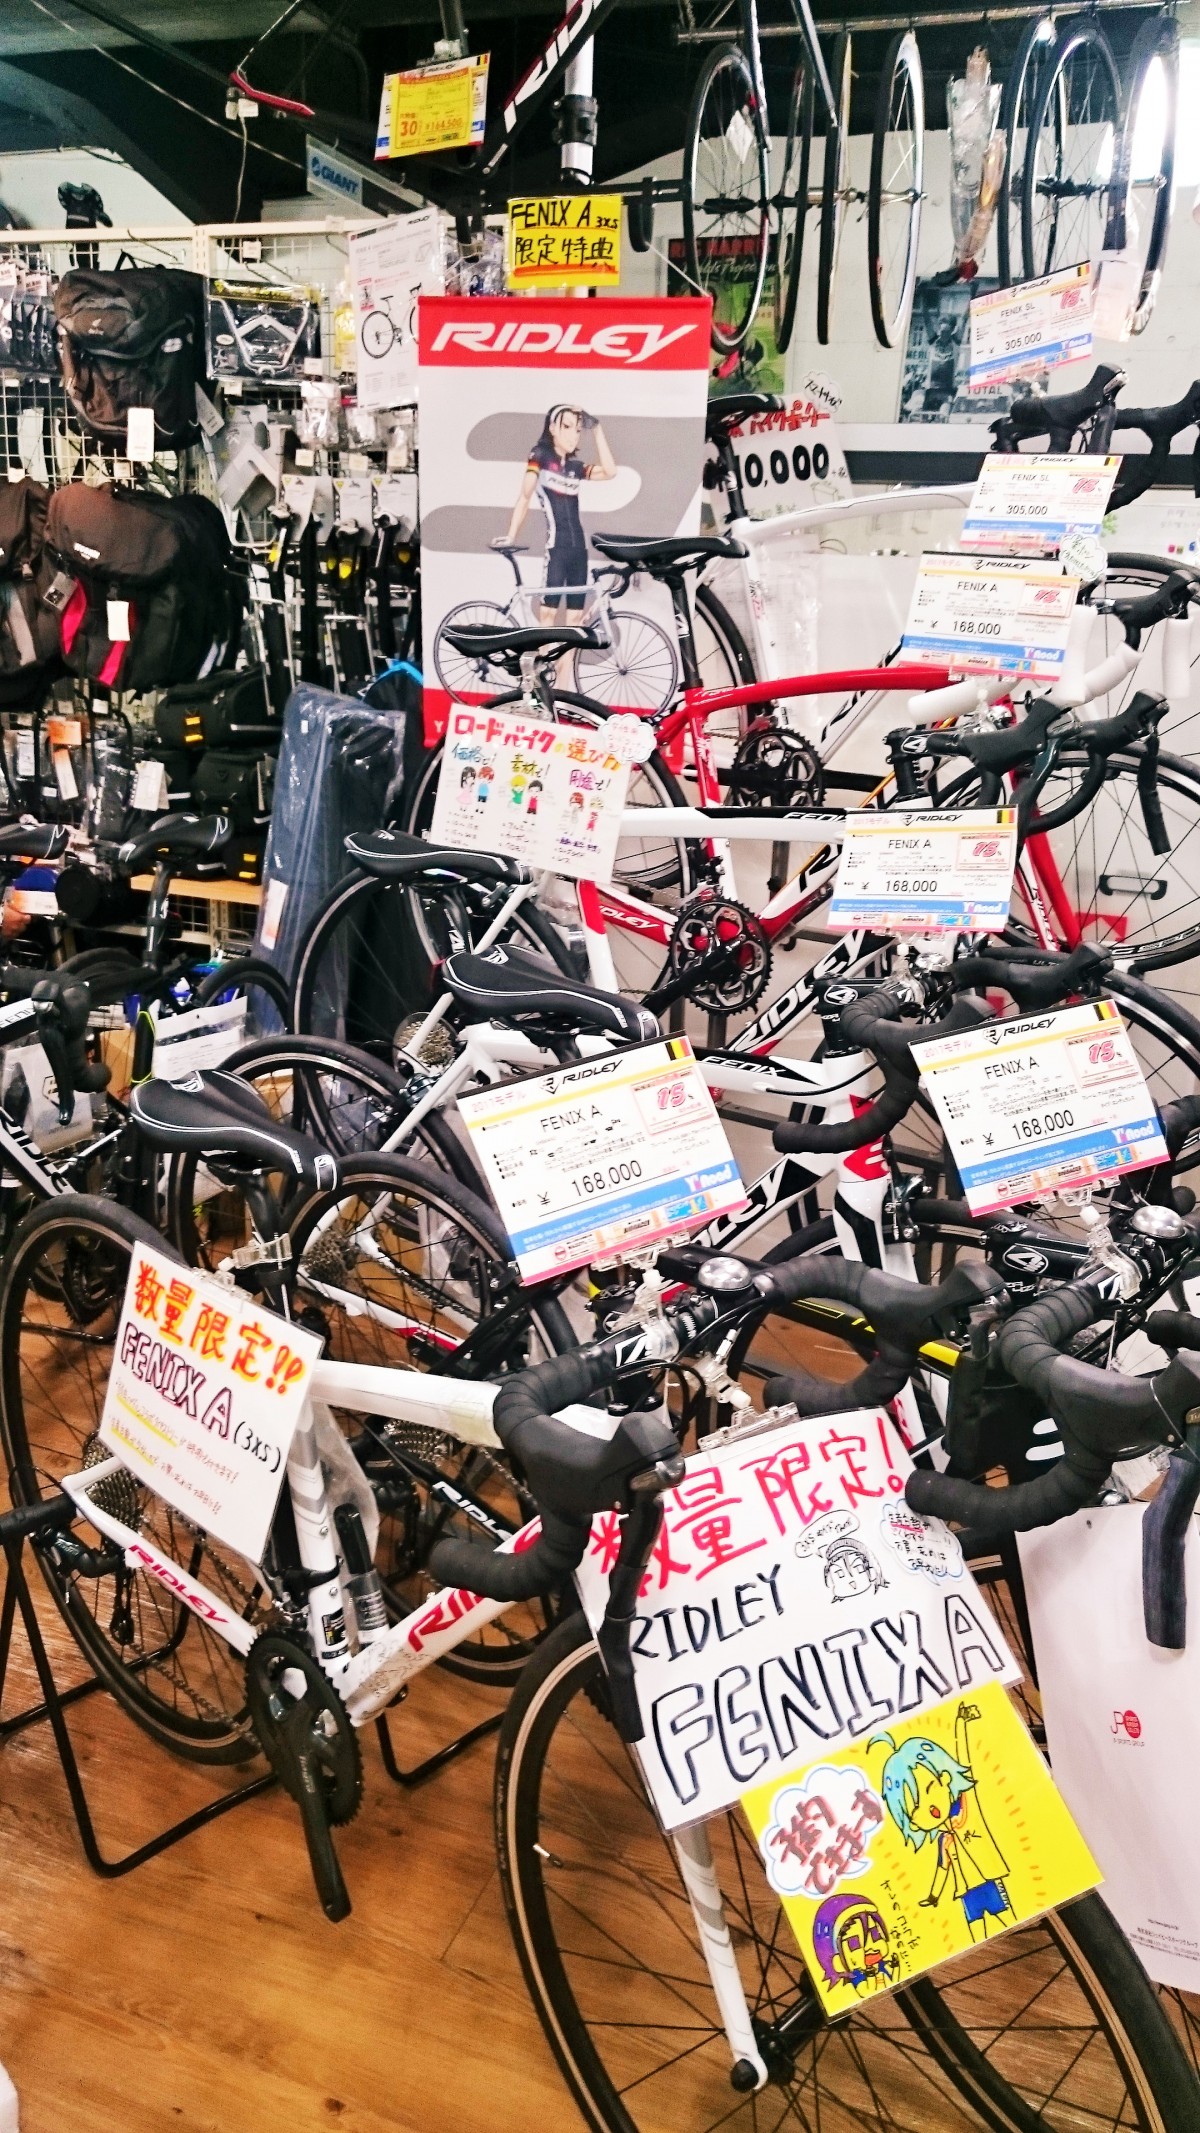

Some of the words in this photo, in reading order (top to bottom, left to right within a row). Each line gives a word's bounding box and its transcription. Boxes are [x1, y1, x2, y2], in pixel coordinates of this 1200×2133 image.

[400, 121, 418, 137] 30
[321, 165, 358, 194] GIANT
[511, 200, 572, 229] FENIX
[577, 199, 591, 228] A
[514, 233, 614, 268] 限定特典
[1000, 305, 1023, 318] FENIX
[1025, 302, 1036, 312] SL
[430, 322, 698, 364] RIDLEY
[1005, 332, 1042, 351] 305,000
[1012, 473, 1037, 482] FENIX
[1040, 474, 1051, 482] SL
[1006, 505, 1048, 516] 305,000
[985, 561, 1031, 570] RIDLEY
[958, 581, 988, 593] FENIX
[989, 583, 998, 593] A
[953, 620, 1001, 636] 168,000
[915, 814, 963, 823] RIDLEY
[888, 839, 920, 849] FENIX
[923, 839, 932, 848] A
[885, 880, 938, 894] 168,000
[1003, 1017, 1057, 1038] RIDLEY
[562, 1059, 623, 1085] RIDLEY
[984, 1060, 1024, 1080] FENIX
[1029, 1056, 1040, 1069] A
[540, 1110, 585, 1133] FENIX
[590, 1105, 603, 1118] A
[982, 1132, 995, 1147] ¥
[1011, 1109, 1074, 1141] 168,000
[537, 1191, 550, 1206] ¥
[571, 1160, 643, 1197] 168,000
[134, 1260, 306, 1396] 数量限定!!
[128, 1544, 230, 1624] RIDLEY
[630, 1563, 785, 1664] RIDLEY
